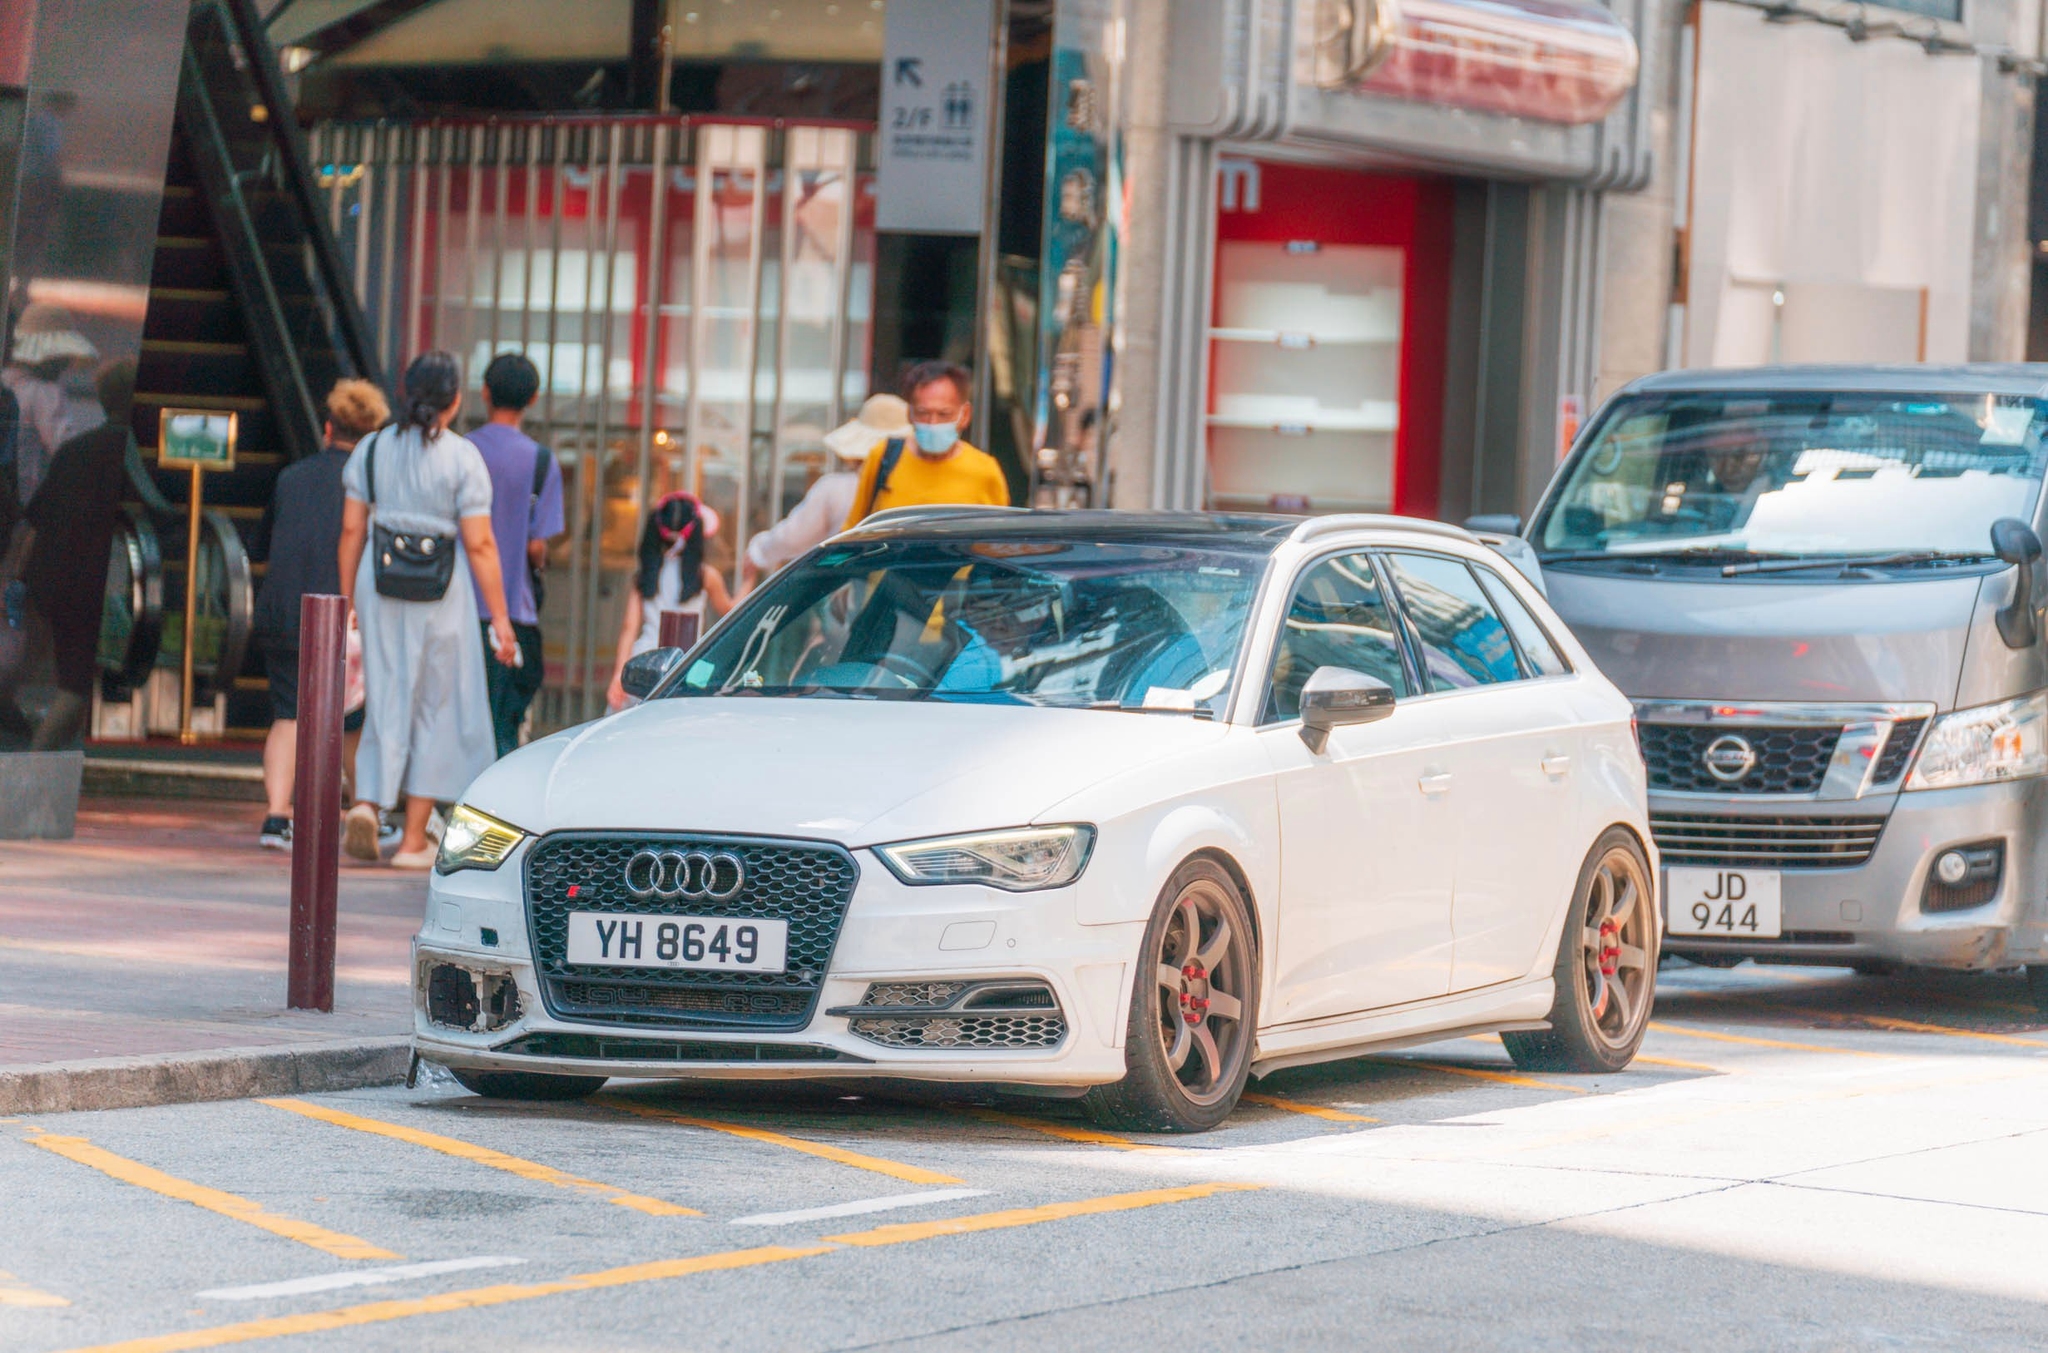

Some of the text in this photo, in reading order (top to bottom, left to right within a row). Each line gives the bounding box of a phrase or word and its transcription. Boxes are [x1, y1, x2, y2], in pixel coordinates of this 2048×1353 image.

[1703, 872, 1747, 900] JD
[1691, 902, 1760, 932] 944
[596, 919, 759, 964] YH 8649
